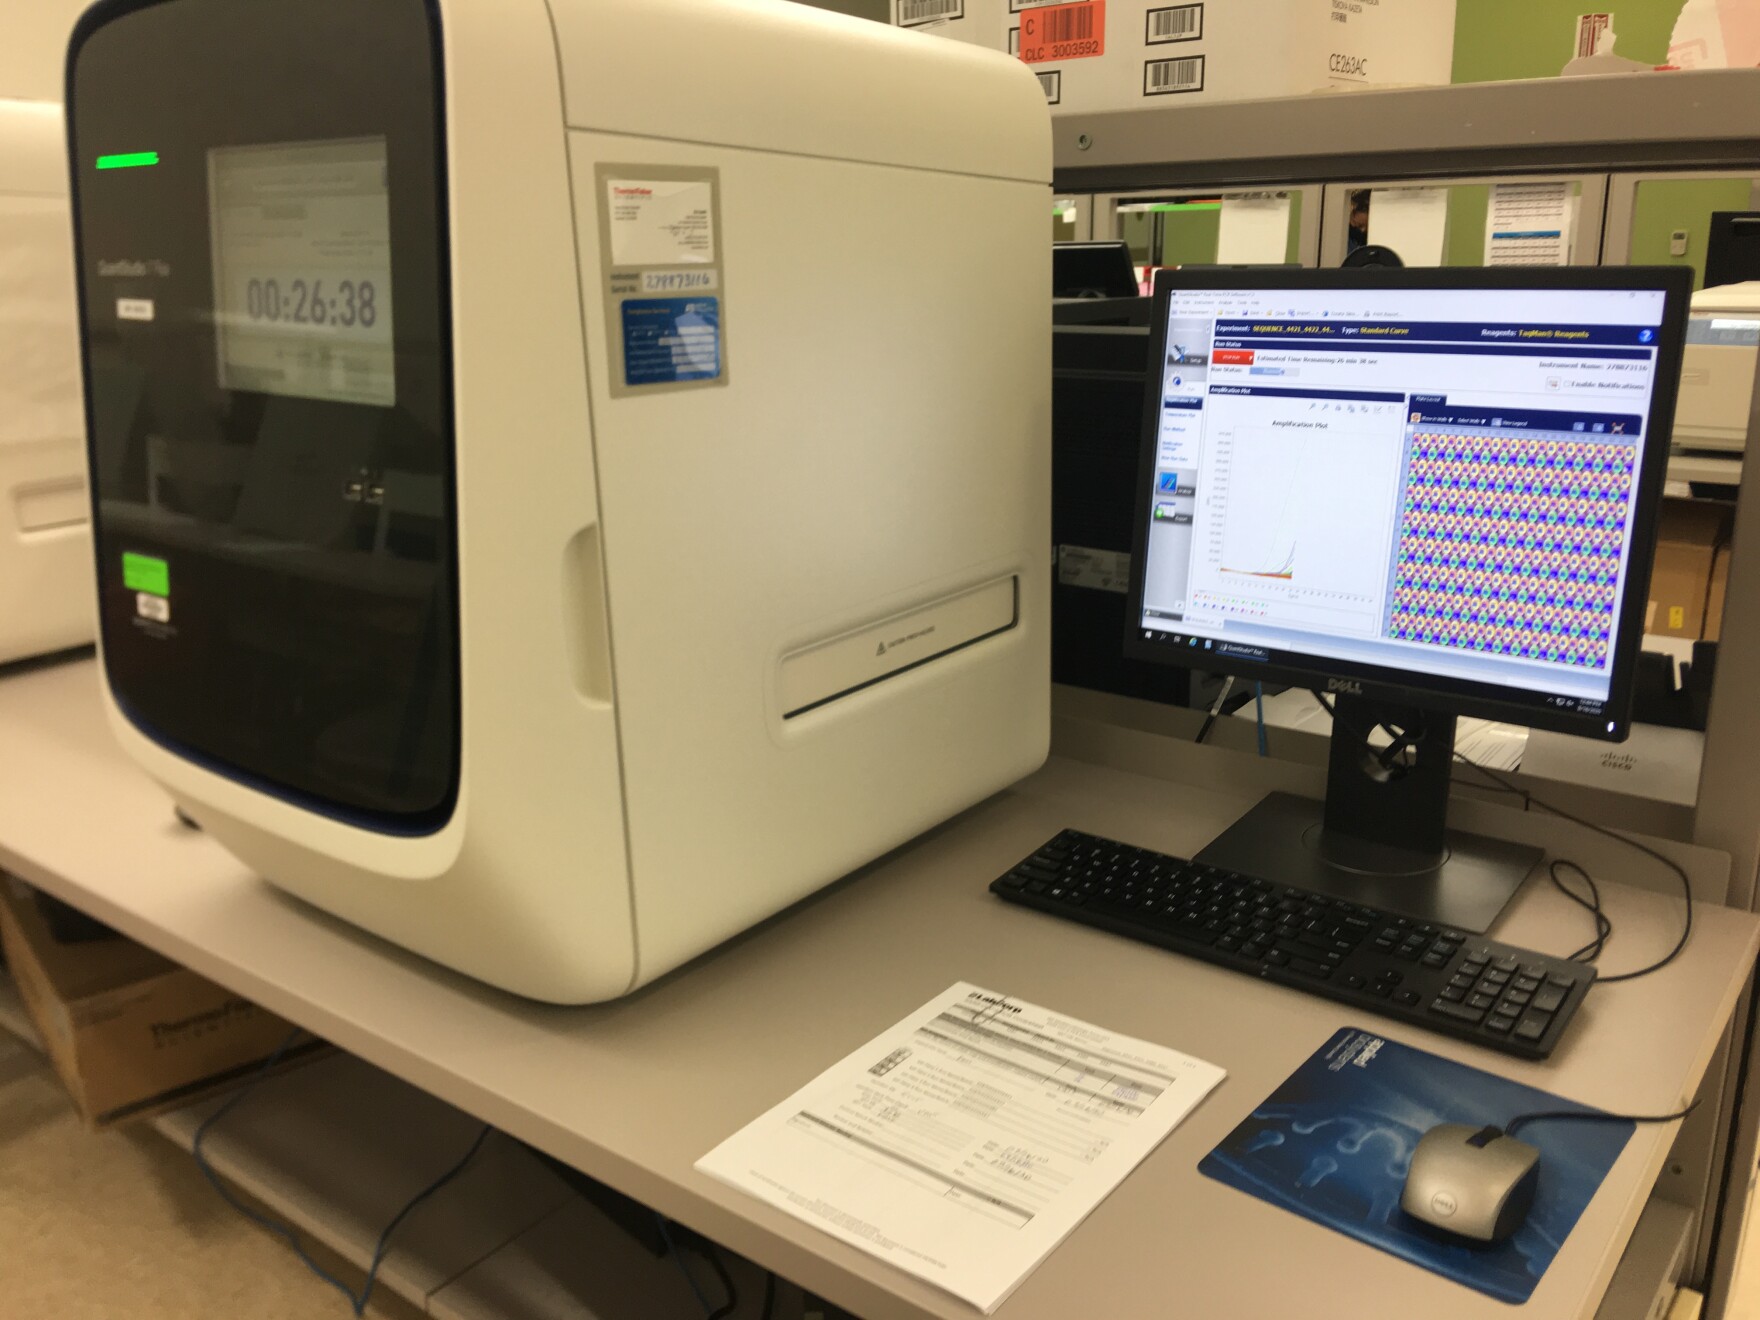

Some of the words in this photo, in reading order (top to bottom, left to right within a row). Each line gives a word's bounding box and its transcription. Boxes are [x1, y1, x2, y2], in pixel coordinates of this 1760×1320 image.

[1025, 18, 1035, 36] C
[1025, 47, 1045, 61] CLC
[1051, 40, 1099, 58] 3003592
[1329, 53, 1368, 76] CE263AC
[247, 278, 377, 328] 00:26:38
[1360, 327, 1389, 335] Standard
[1554, 330, 1590, 339] Reagents
[1327, 678, 1363, 695] DELL
